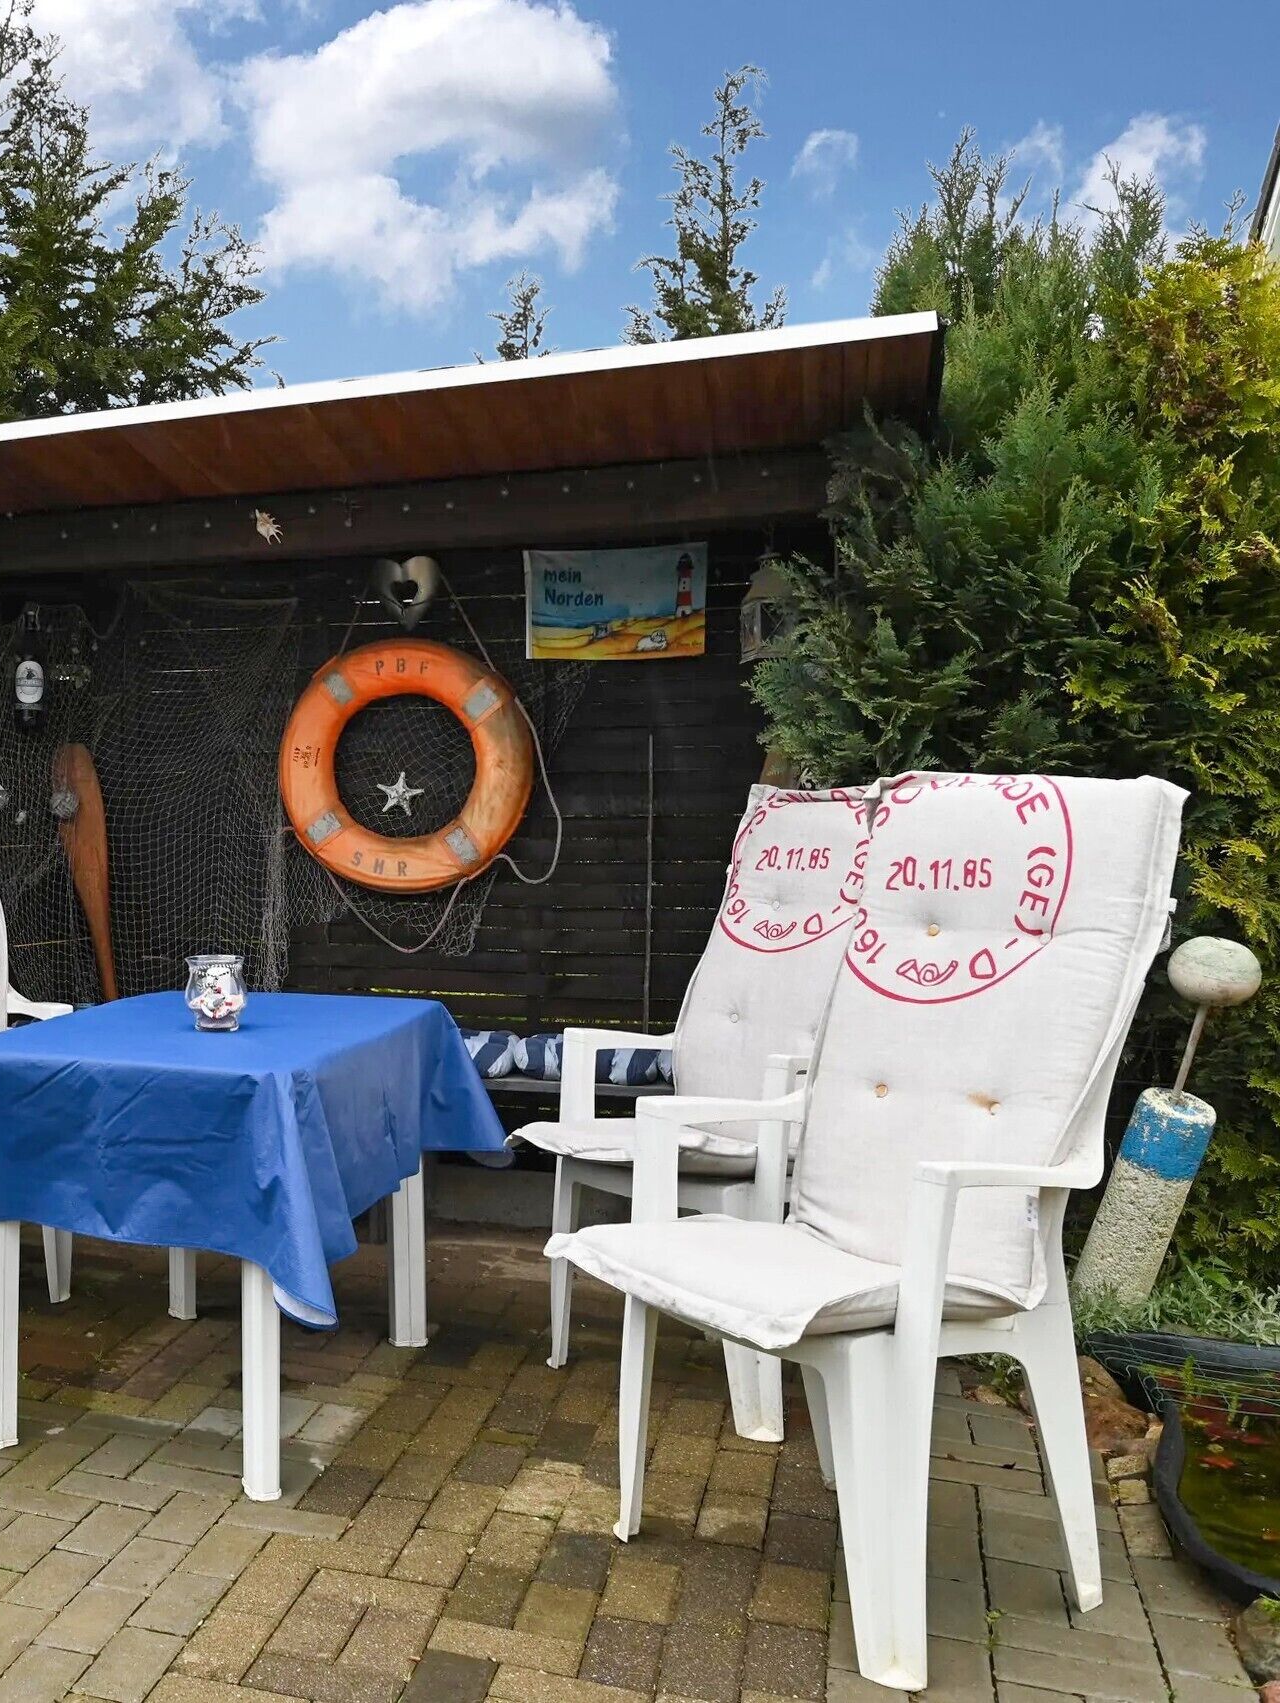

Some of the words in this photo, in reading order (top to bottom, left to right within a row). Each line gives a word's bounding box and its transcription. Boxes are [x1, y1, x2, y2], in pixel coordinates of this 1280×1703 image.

[543, 567, 582, 583] mein
[544, 588, 604, 607] Norden
[754, 845, 832, 874] 20.11.85
[885, 855, 993, 891] 20.11.85
